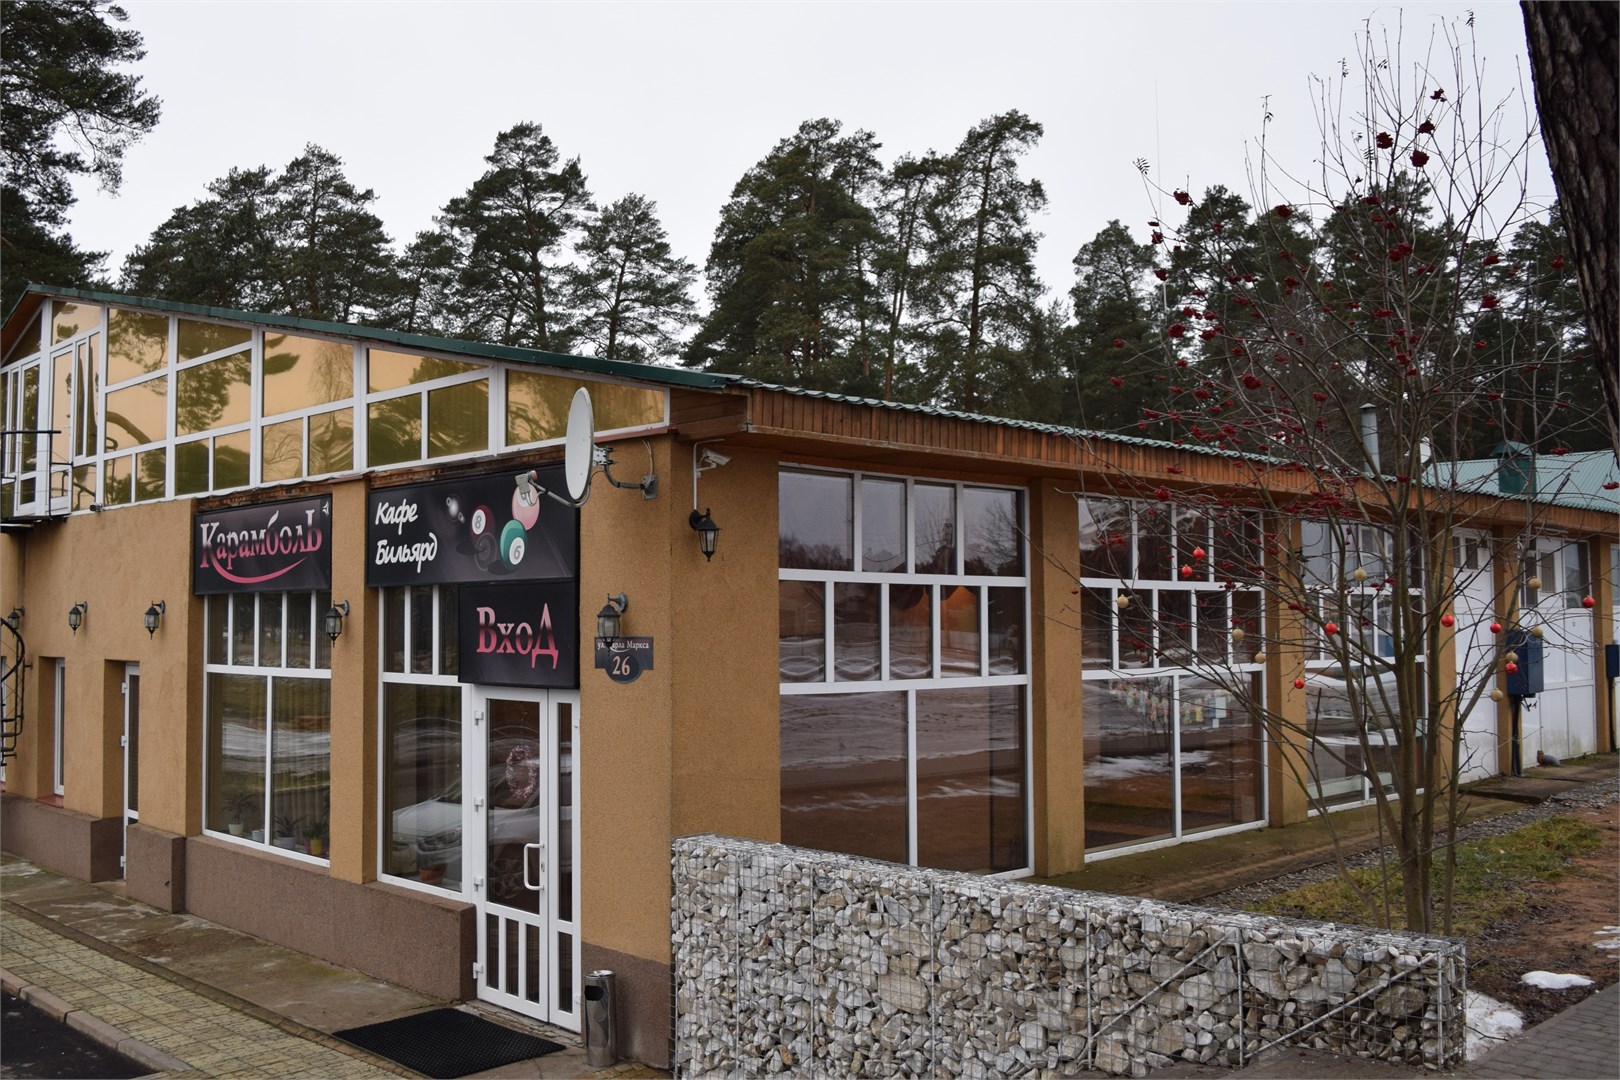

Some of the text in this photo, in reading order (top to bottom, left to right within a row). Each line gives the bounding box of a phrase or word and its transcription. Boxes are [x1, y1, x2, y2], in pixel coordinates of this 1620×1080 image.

[375, 498, 419, 535] Кафе
[474, 514, 483, 530] 8
[375, 532, 438, 574] Бильярд
[513, 545, 522, 560] 6
[609, 642, 626, 650] арла
[627, 640, 650, 651] Маркса
[612, 655, 631, 676] 26
